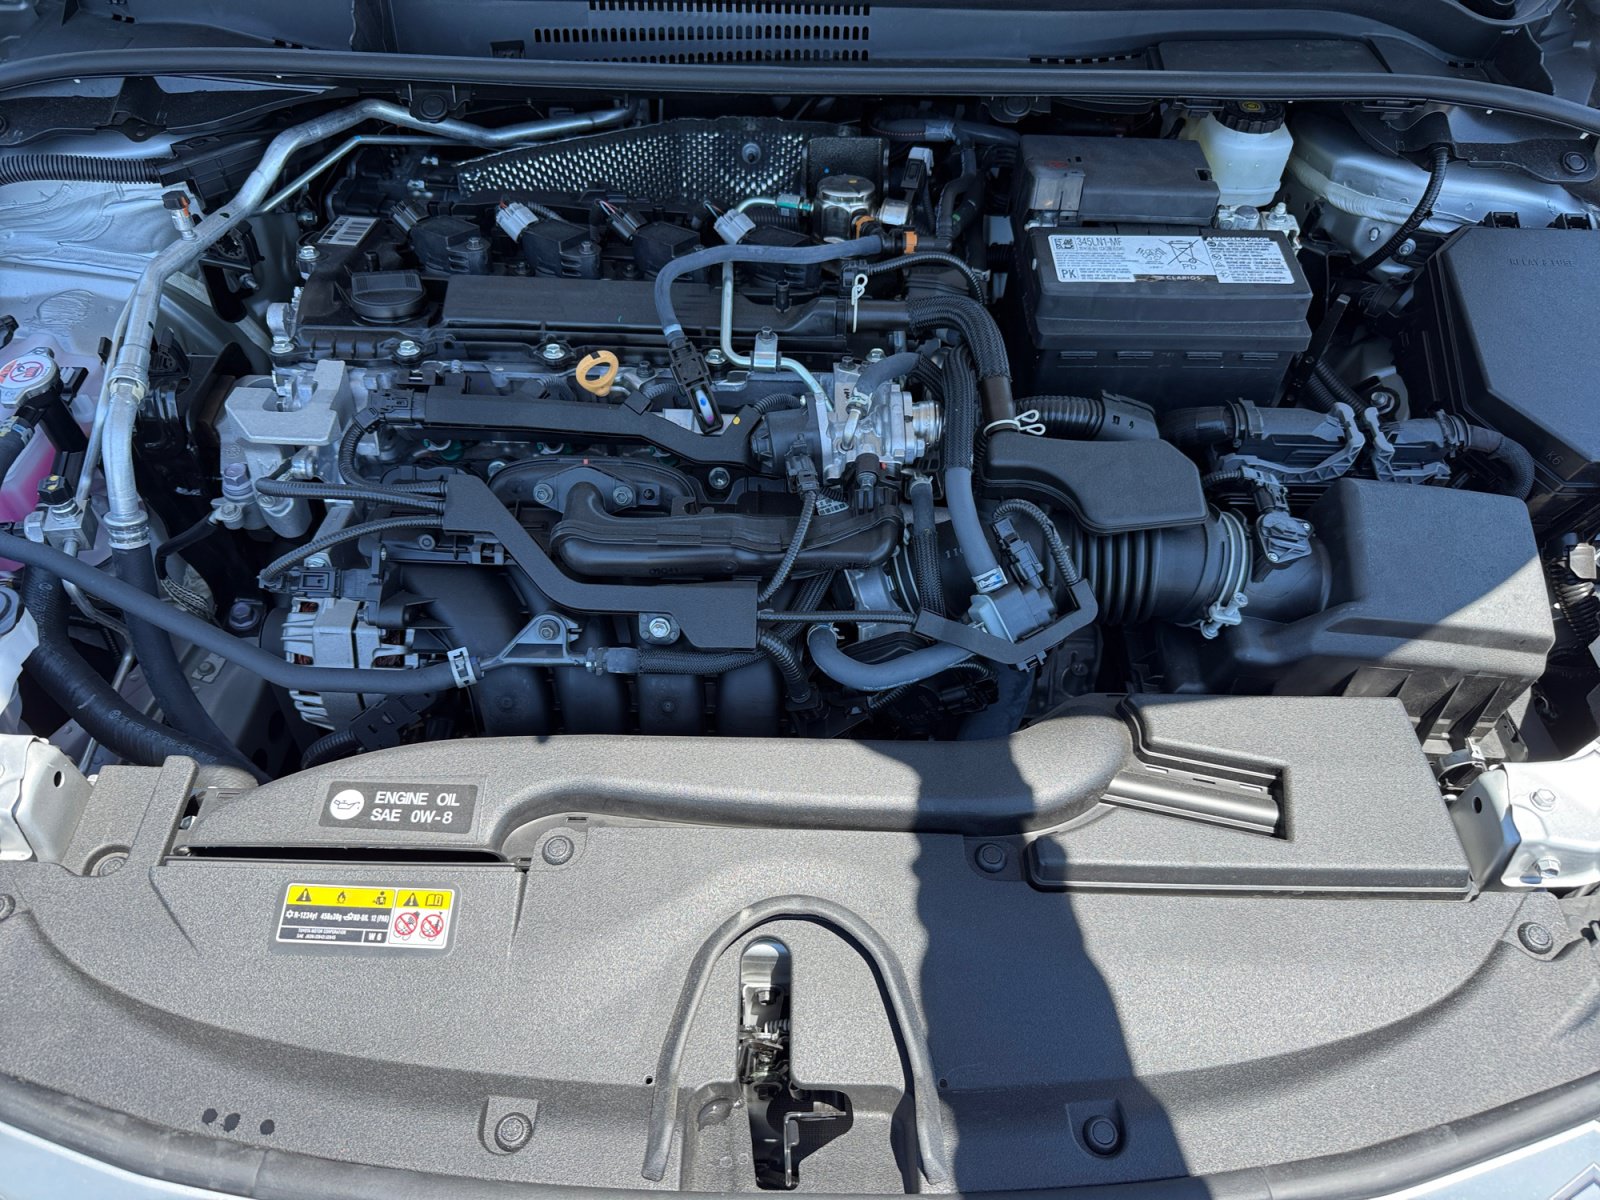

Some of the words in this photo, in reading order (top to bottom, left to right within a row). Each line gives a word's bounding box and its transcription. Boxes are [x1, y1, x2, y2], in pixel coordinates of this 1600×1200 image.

[1062, 269, 1077, 279] PK
[374, 791, 429, 805] ENGINE
[436, 792, 460, 807] OIL
[370, 808, 402, 822] SAE
[410, 809, 453, 824] 0W-8
[368, 933, 376, 941] W
